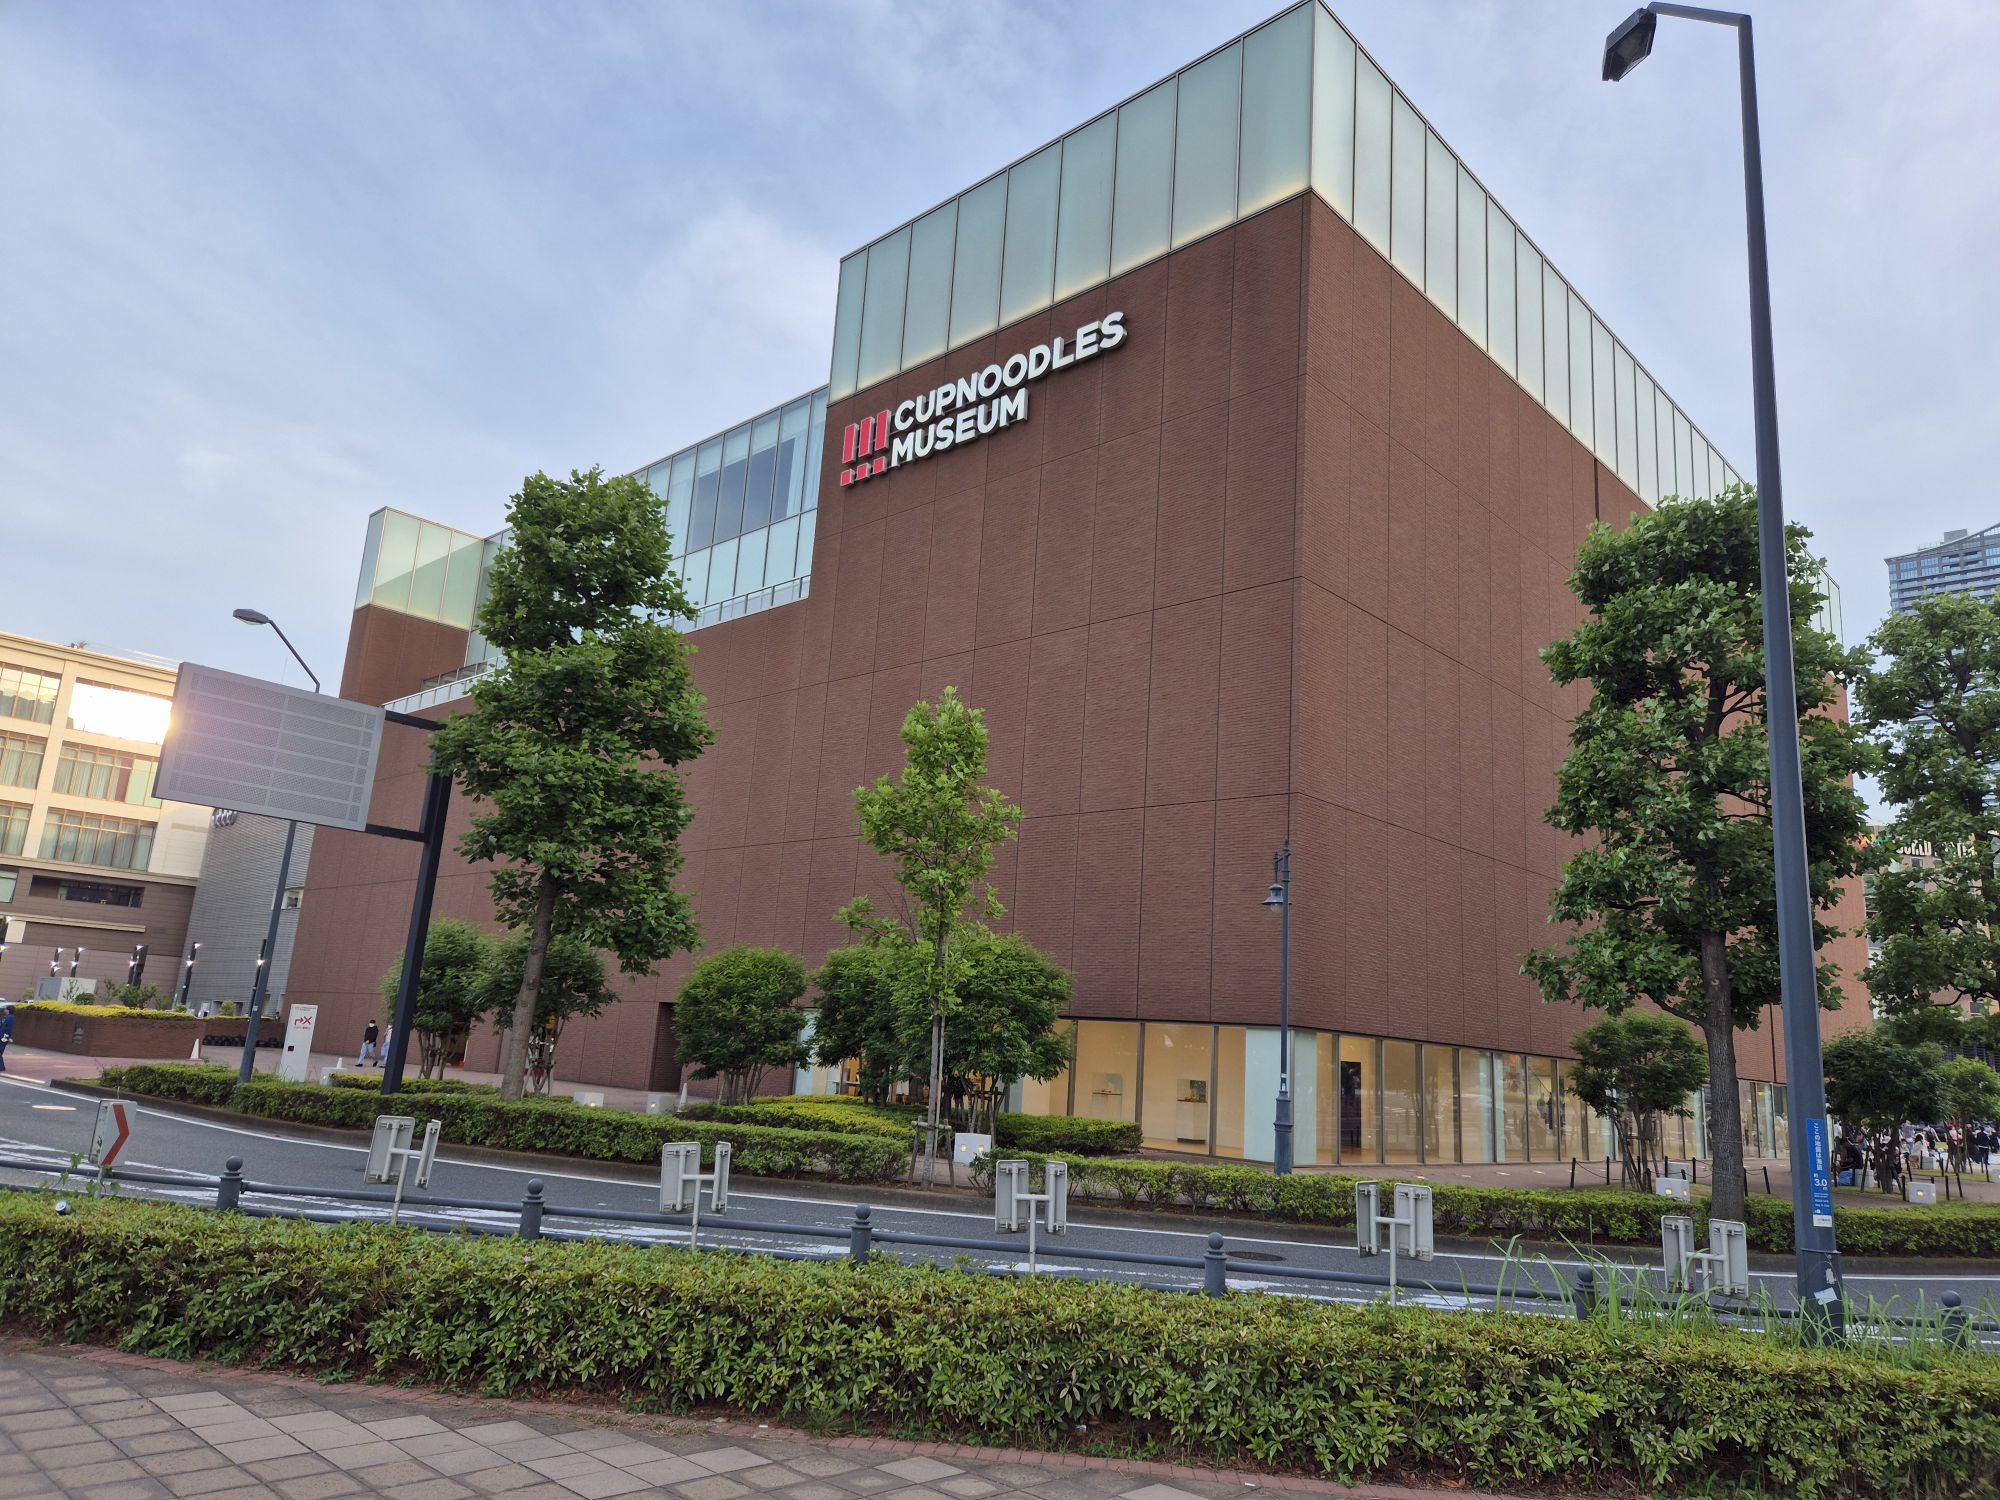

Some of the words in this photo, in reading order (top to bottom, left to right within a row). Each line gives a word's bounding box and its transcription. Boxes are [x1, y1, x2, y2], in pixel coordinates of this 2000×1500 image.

[894, 311, 1127, 431] CUPNOODLES
[890, 387, 1028, 469] MUSEUM
[1814, 1178, 1828, 1187] 3.0
